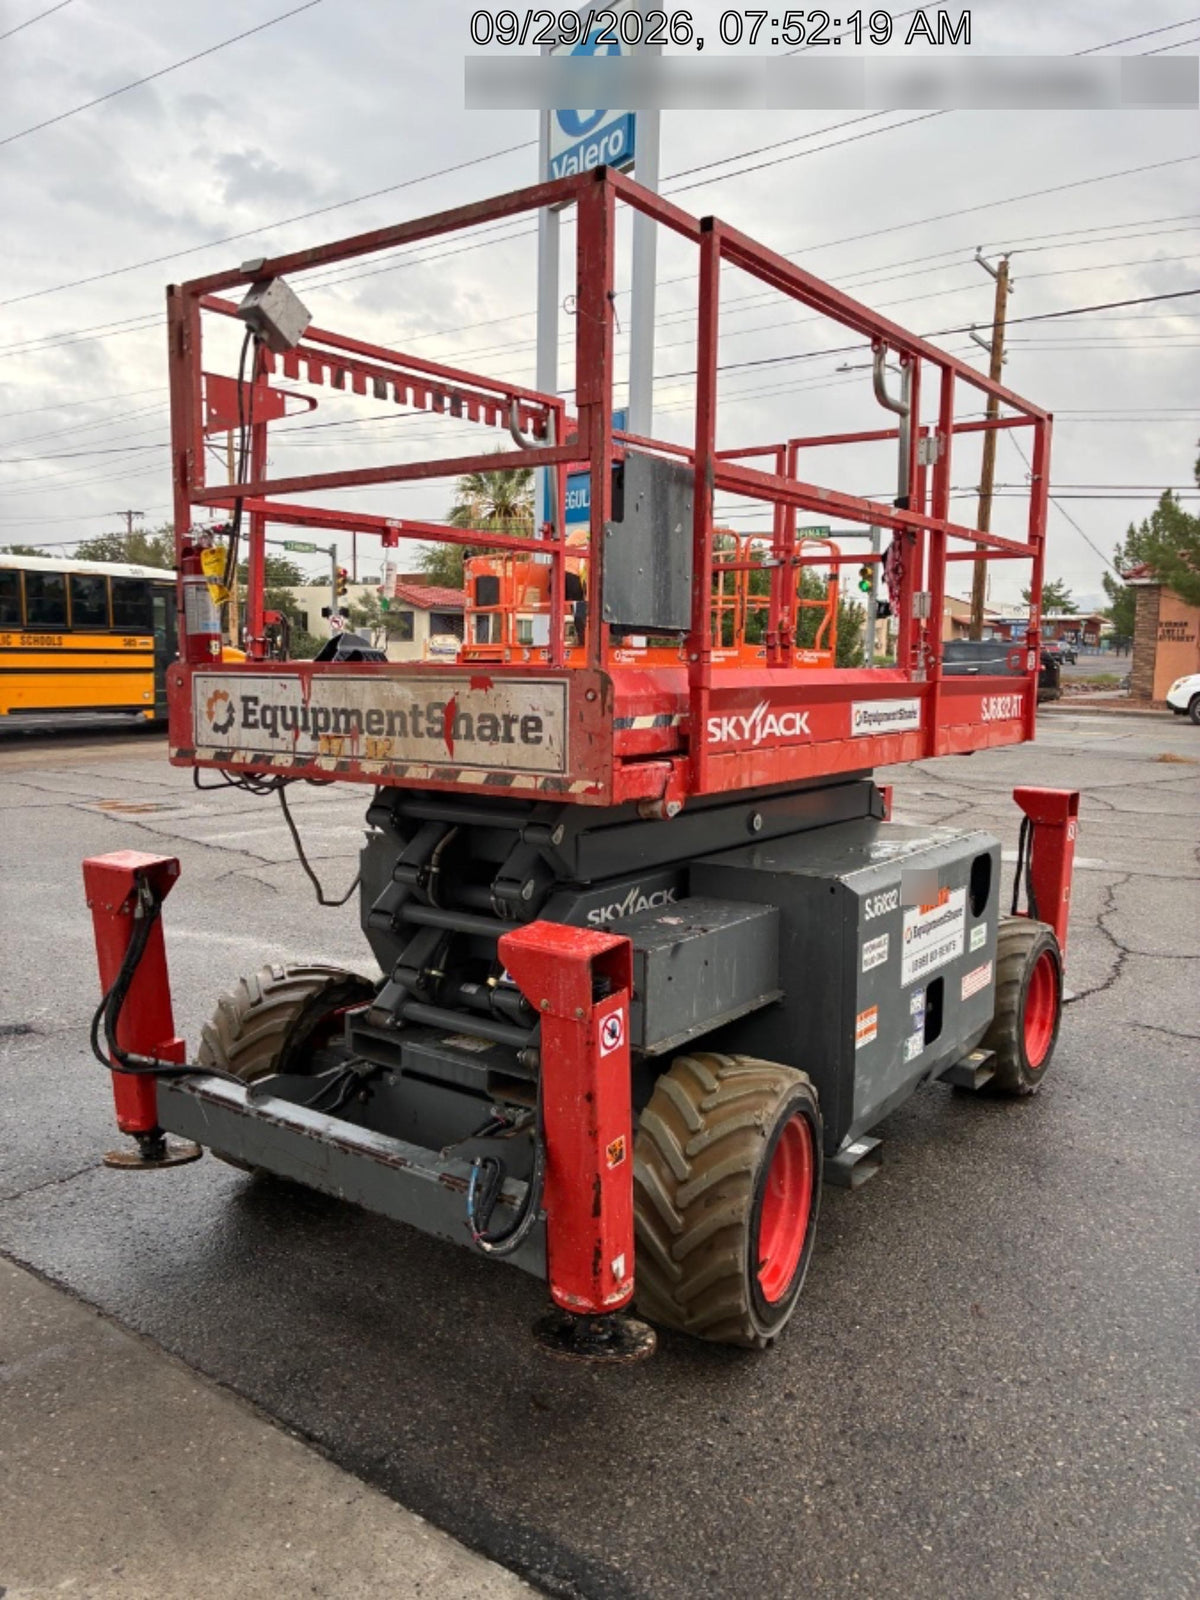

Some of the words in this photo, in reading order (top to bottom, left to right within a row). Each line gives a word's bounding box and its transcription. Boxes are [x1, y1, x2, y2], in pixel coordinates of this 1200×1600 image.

[552, 129, 624, 179] Valero
[21, 635, 63, 647] SCHOOLS
[240, 695, 544, 746] EquipmentShare
[706, 700, 811, 745] SKYJACK
